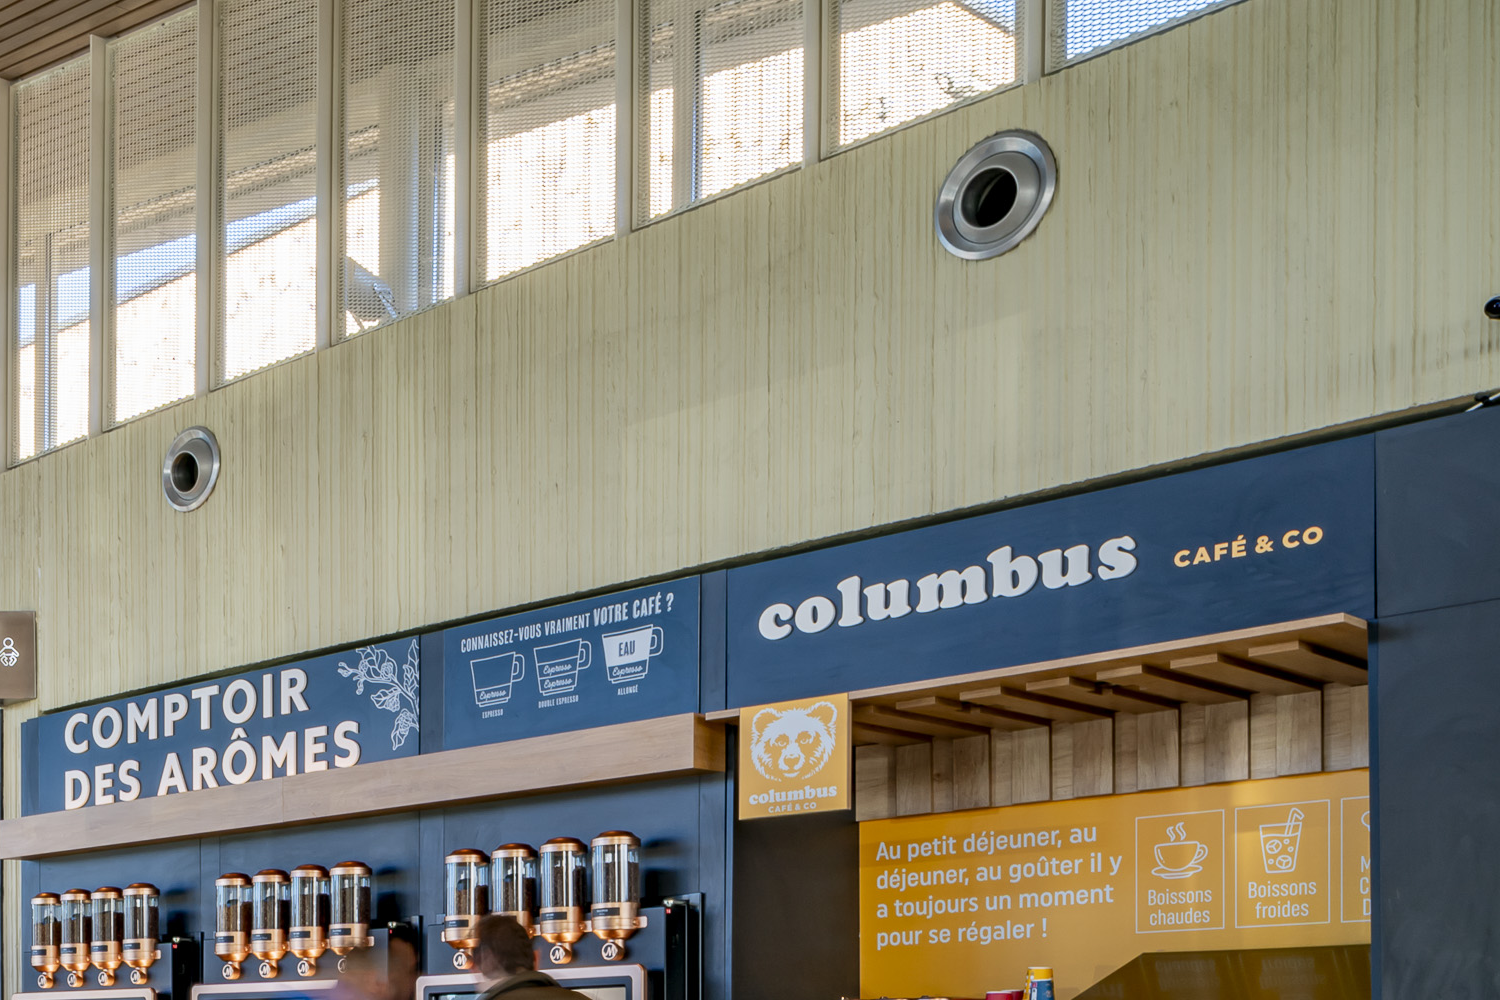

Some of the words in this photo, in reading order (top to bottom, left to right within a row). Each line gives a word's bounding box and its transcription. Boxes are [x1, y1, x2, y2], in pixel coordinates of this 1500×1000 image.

[1174, 536, 1246, 568] CAFÉ
[1254, 535, 1274, 554] &
[1282, 526, 1324, 550] CO
[758, 535, 1138, 641] columbus
[461, 623, 542, 653] CONNAISSEZ-VOUS
[544, 613, 591, 636] VRAIMENT
[592, 602, 629, 627] VOTRE
[632, 592, 662, 619] CAFÉ
[666, 592, 675, 613] ?
[618, 640, 636, 657] EAU
[543, 661, 572, 675] Espresso
[612, 665, 643, 677] Espresso
[543, 676, 573, 689] Espresso
[617, 684, 638, 695] ALLONGÉ
[479, 689, 507, 701] Espresso
[538, 698, 555, 708] DOUBLE
[556, 694, 579, 706] ESPRESSO
[64, 668, 309, 754] COMPTOIR
[482, 708, 504, 719] ESPRESSO
[64, 760, 141, 811] DES
[157, 720, 361, 796] ARÔMES
[749, 785, 838, 805] columbus
[768, 803, 792, 813] CAFÉ
[803, 802, 817, 810] CO
[876, 842, 901, 861] Au
[907, 836, 956, 862] petit
[963, 830, 1062, 854] déjeuner,
[1069, 826, 1097, 844] au
[876, 867, 969, 891] déjeuner,
[976, 865, 1001, 882] au
[1009, 856, 1083, 883] goûter
[1090, 852, 1102, 873] il
[1109, 855, 1122, 876] y
[1147, 889, 1212, 906] Boissons
[1248, 881, 1317, 899] Boissons
[876, 903, 888, 918] a
[894, 895, 979, 919] toujours
[985, 894, 1011, 911] un
[1019, 884, 1114, 908] moment
[1255, 901, 1309, 918] froides
[1150, 908, 1211, 926] chaudes
[876, 929, 923, 950] pour
[928, 927, 951, 944] se
[958, 920, 1035, 945] régaler
[1042, 917, 1047, 938] !
